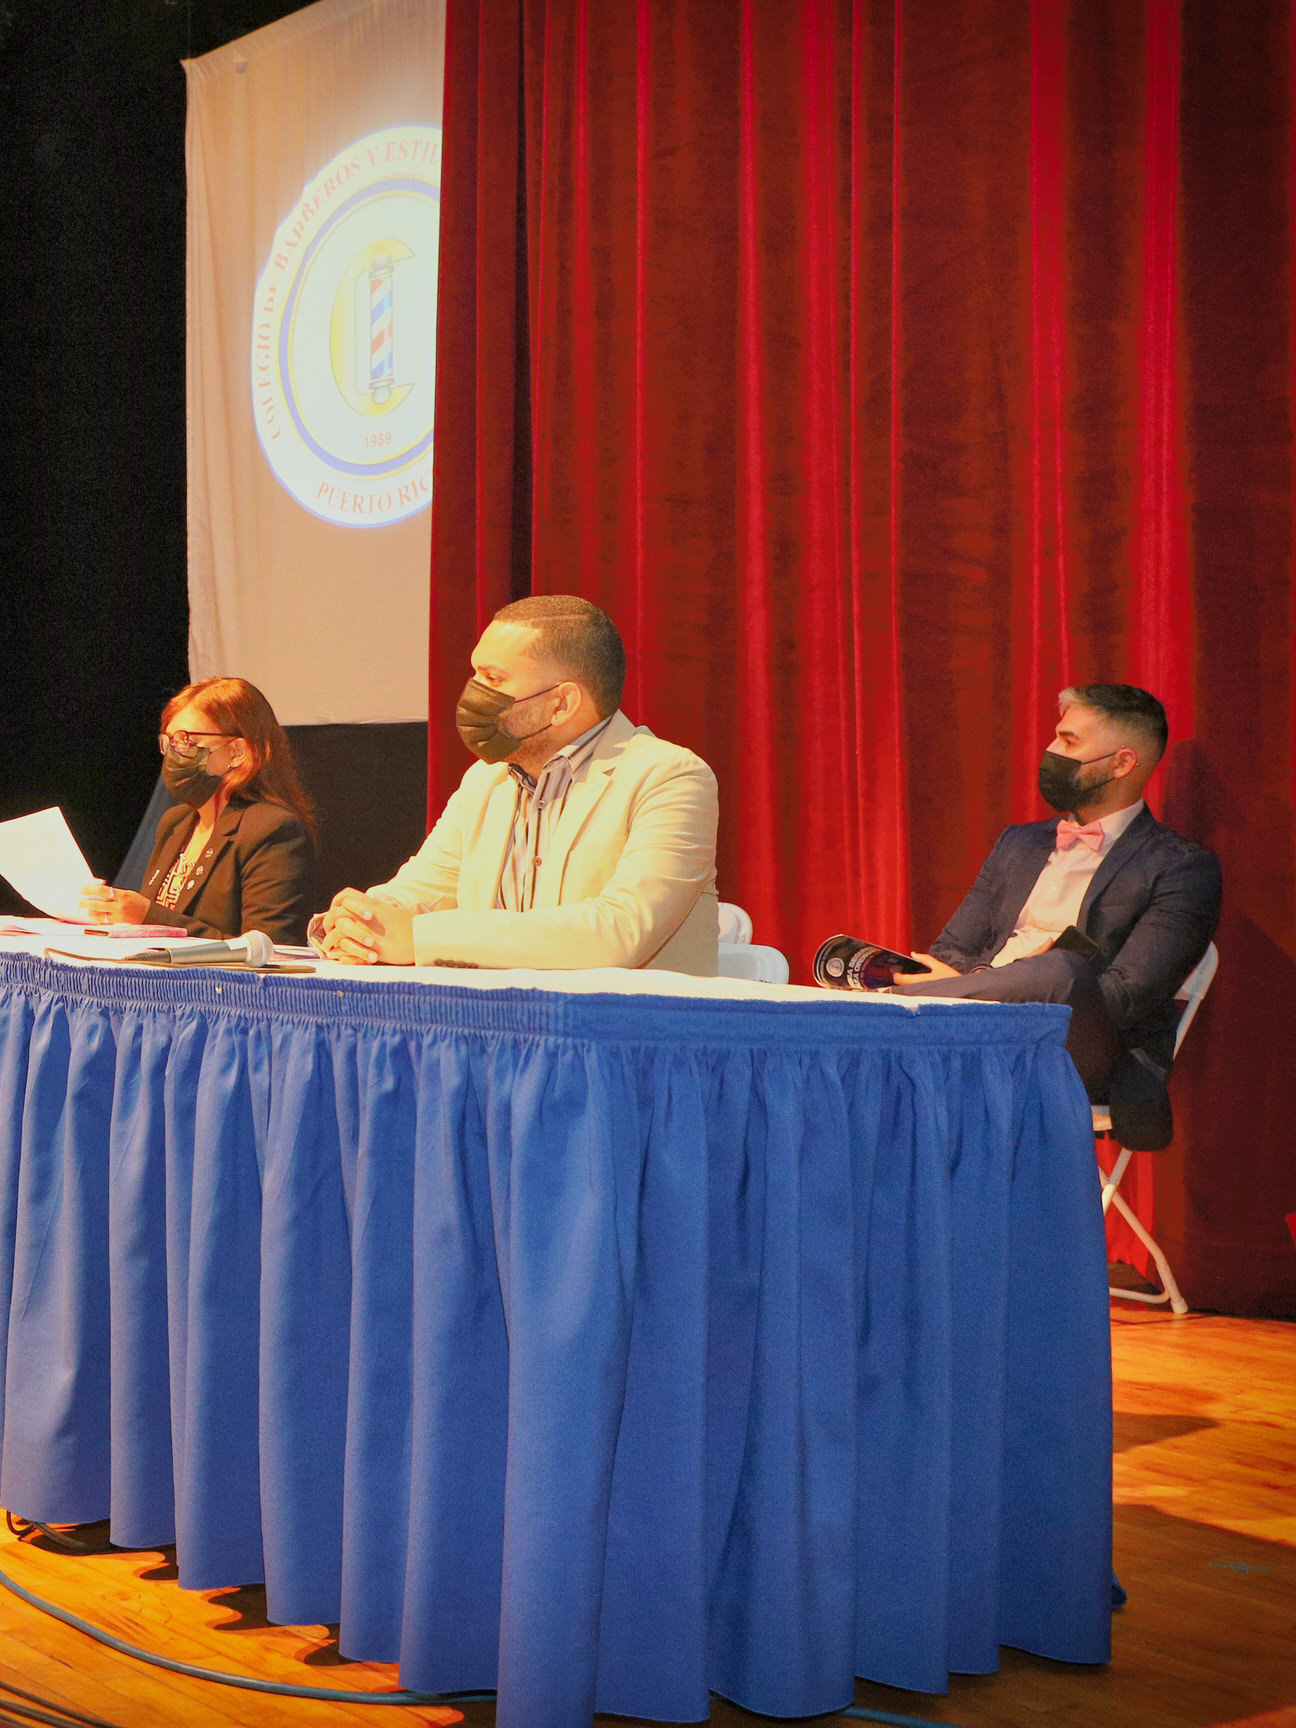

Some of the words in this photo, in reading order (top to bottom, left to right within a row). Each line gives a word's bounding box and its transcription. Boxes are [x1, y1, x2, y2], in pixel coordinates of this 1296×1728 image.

[365, 144, 379, 167] Y
[385, 139, 439, 166] ESTIL
[273, 156, 361, 270] BARBEROS
[263, 279, 279, 313] DE
[257, 322, 281, 440] COLEGIO
[364, 431, 392, 449] 1989
[316, 479, 393, 514] PUERTO
[397, 469, 431, 506] RIC
